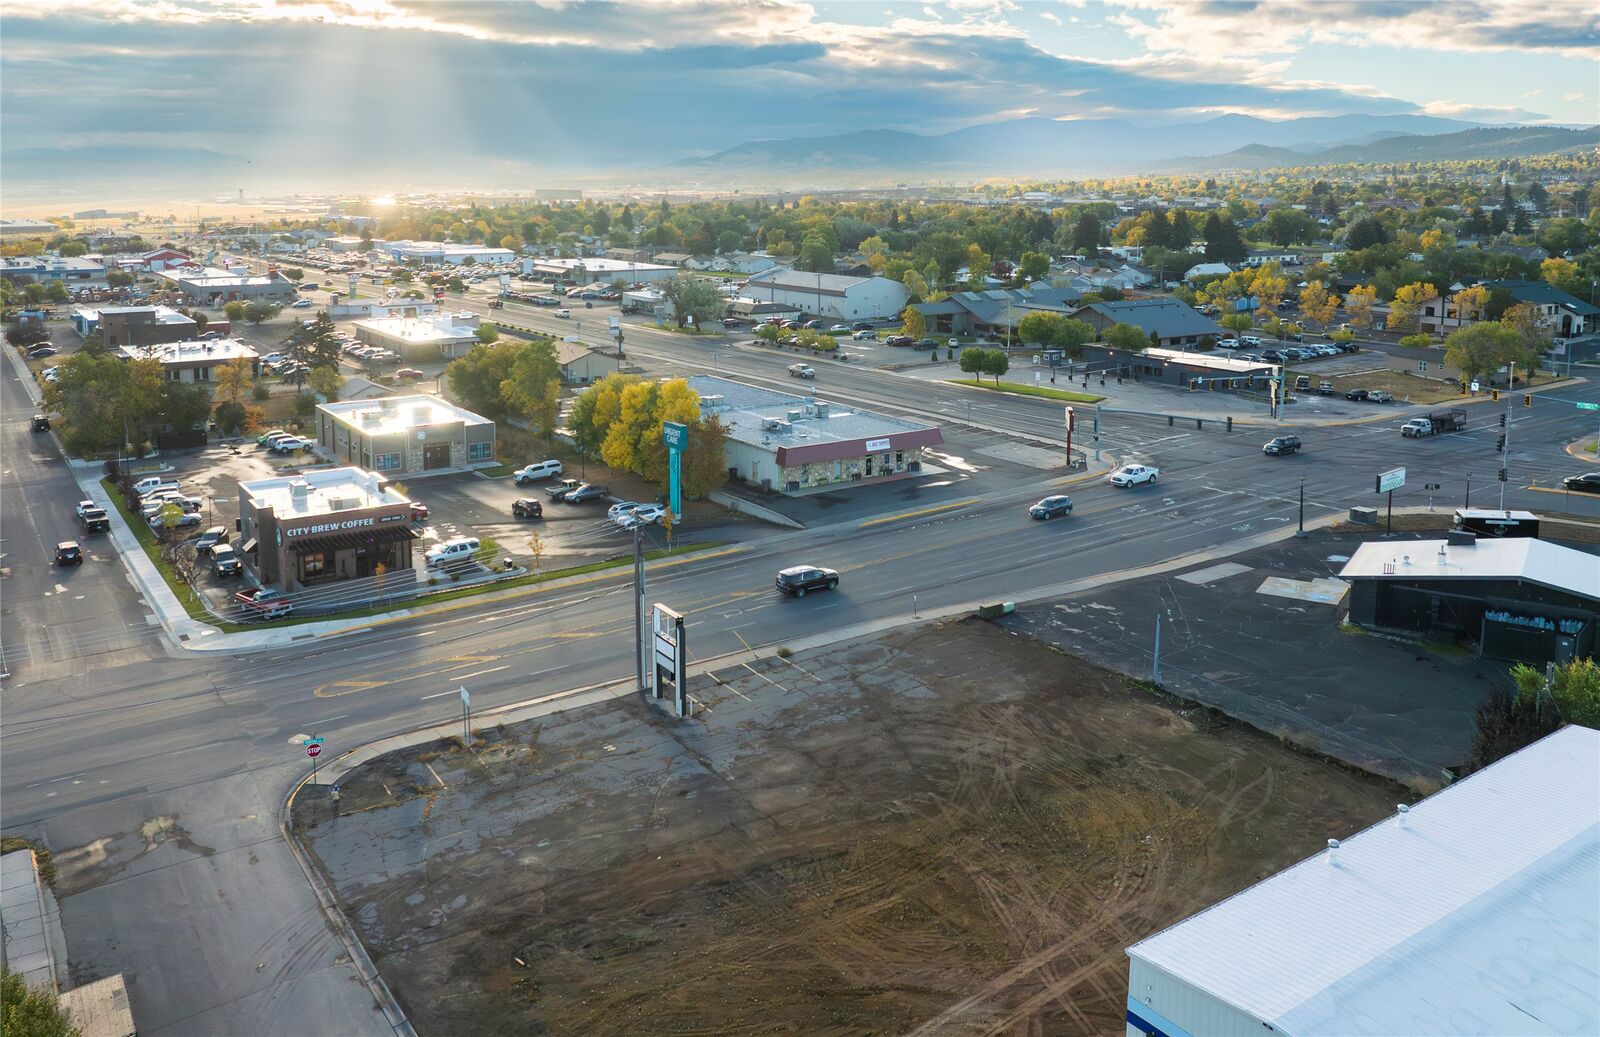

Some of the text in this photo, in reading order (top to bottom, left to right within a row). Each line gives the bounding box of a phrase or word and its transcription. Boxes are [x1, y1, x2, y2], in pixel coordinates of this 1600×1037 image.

[664, 426, 681, 437] URGENT
[667, 434, 679, 445] CARE
[287, 527, 309, 537] CITY
[311, 522, 340, 533] BREW
[341, 517, 375, 529] COFFEE
[307, 746, 321, 754] STOP
